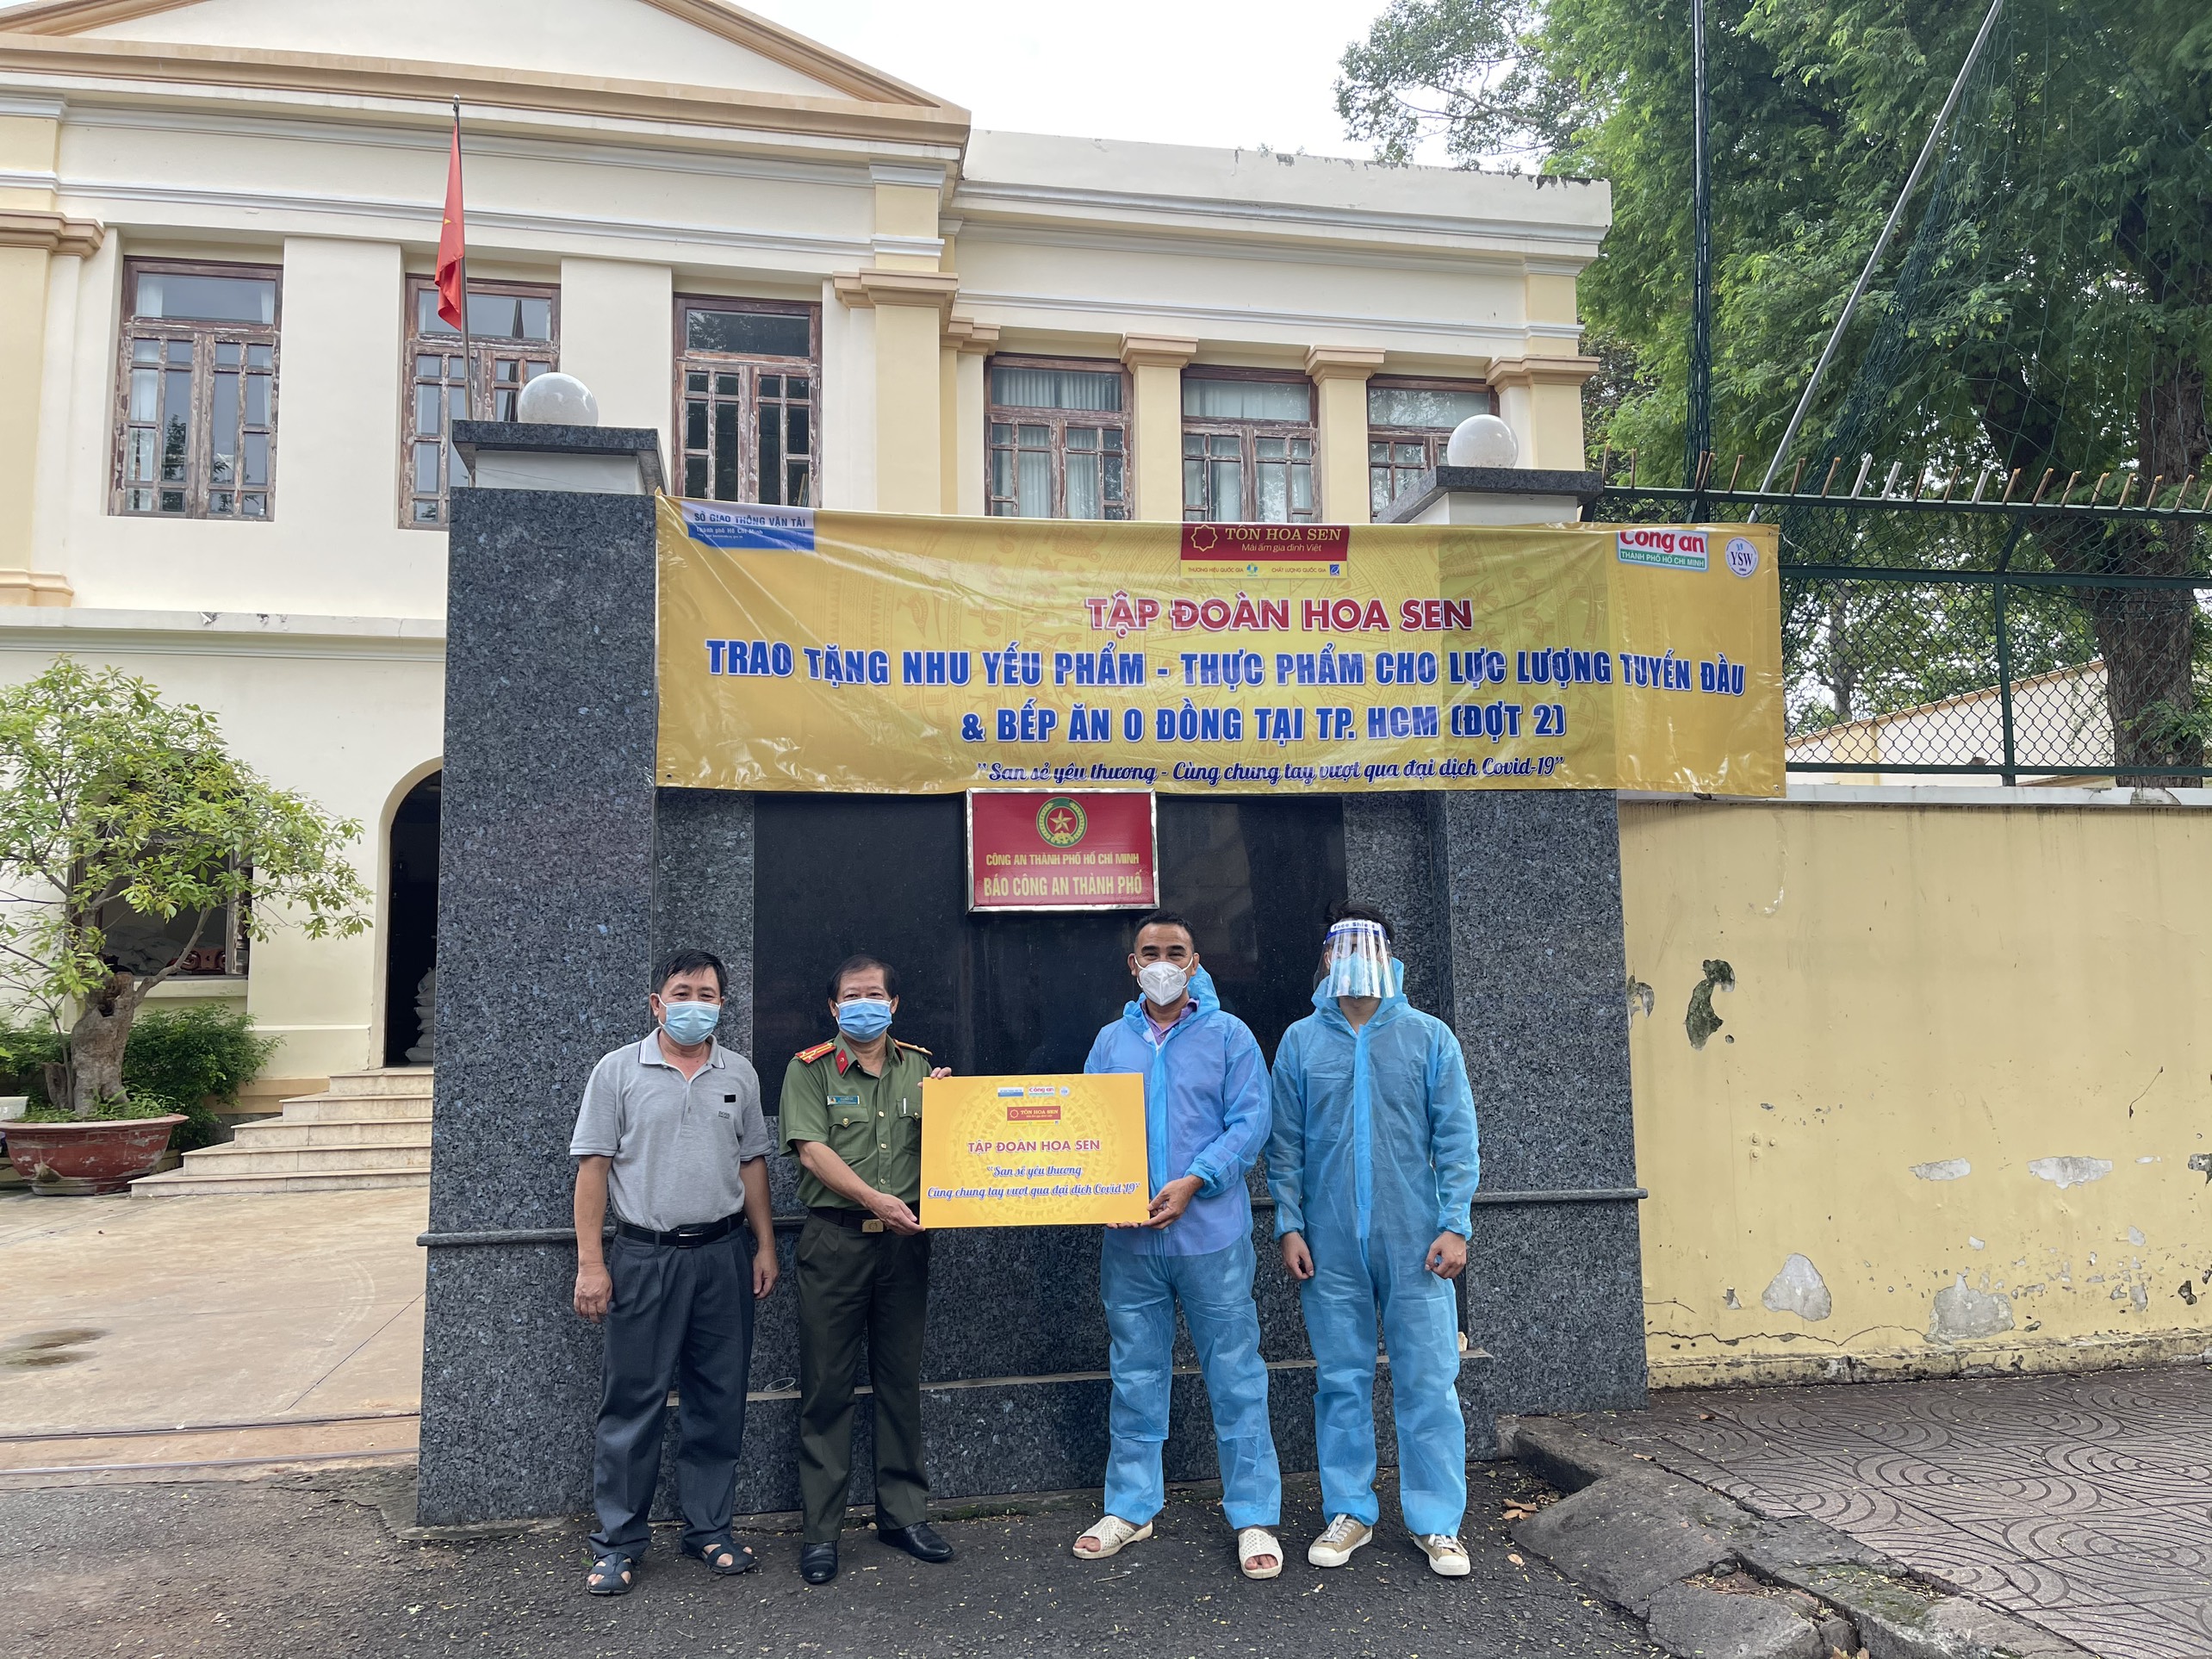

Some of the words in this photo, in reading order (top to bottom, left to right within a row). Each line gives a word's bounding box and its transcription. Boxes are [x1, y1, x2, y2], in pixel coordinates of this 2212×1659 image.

[710, 514, 731, 523] GIAO
[736, 514, 766, 525] THÔNG
[769, 516, 788, 528] VẬN
[791, 517, 806, 527] TẢI
[1225, 524, 1261, 541] TÔN
[1265, 528, 1302, 541] HOA
[1307, 528, 1342, 541] SEN
[1241, 543, 1258, 551] Mái
[1272, 544, 1285, 553] gia
[1307, 543, 1322, 552] Việt
[1679, 536, 1705, 553] an
[1687, 558, 1705, 567] MINH
[1730, 551, 1753, 567] YSW
[1084, 592, 1160, 638] TẬP
[1170, 592, 1290, 631] ĐOÀN
[1302, 598, 1391, 631] HOA
[1400, 598, 1473, 631] SEN
[705, 639, 794, 677] TRAO
[804, 643, 892, 688] TẶNG
[902, 650, 970, 686] NHU
[981, 639, 1043, 686] YẾU
[1053, 641, 1146, 686] PHẨM
[1156, 666, 1170, 677] -
[1180, 648, 1264, 692] THỰC
[1275, 642, 1365, 686] PHẨM
[1376, 650, 1438, 686] CHO
[1449, 646, 1507, 689] LỰC
[1516, 646, 1613, 689] LƯỢNG
[1619, 648, 1693, 692] TUYẾN
[1699, 652, 1746, 697] ĐẦU
[960, 711, 985, 742] &
[996, 698, 1059, 742] BẾP
[1067, 703, 1111, 742] ĂN
[1156, 697, 1242, 742] ĐỒNG
[1254, 707, 1304, 747] TẠI
[1316, 707, 1357, 741] TP.
[1367, 705, 1438, 740] HCM
[1450, 699, 1522, 743] (ĐỢT
[1533, 703, 1567, 737] 2)
[1030, 761, 1050, 781] sẻ
[1054, 761, 1087, 785] yêu
[1090, 763, 1158, 786] thương
[1172, 761, 1223, 787] Cùng
[1224, 762, 1282, 786] chung
[1283, 762, 1317, 786] tay
[1319, 761, 1360, 783] vượt
[1364, 763, 1401, 785] qua
[1402, 757, 1435, 781] đại
[1438, 757, 1478, 781] dịch
[985, 852, 1011, 866] CÔNG
[1014, 854, 1028, 865] AN
[1029, 852, 1060, 865] THÀNH
[1097, 851, 1113, 865] CHÍ
[1115, 853, 1140, 864] MINH
[984, 873, 1010, 897] BÁO
[1012, 873, 1048, 897] CÔNG
[1052, 877, 1069, 896] AN
[1073, 873, 1114, 896] THÀNH
[1117, 869, 1143, 895] PHỐ
[967, 1140, 992, 1156] TẬP
[996, 1139, 1037, 1153] ĐOÀN
[1041, 1140, 1072, 1151] HOA
[1075, 1140, 1101, 1150] SEN
[1028, 1165, 1046, 1179] yêu
[955, 1187, 985, 1200] chung
[1030, 1187, 1049, 1198] qua
